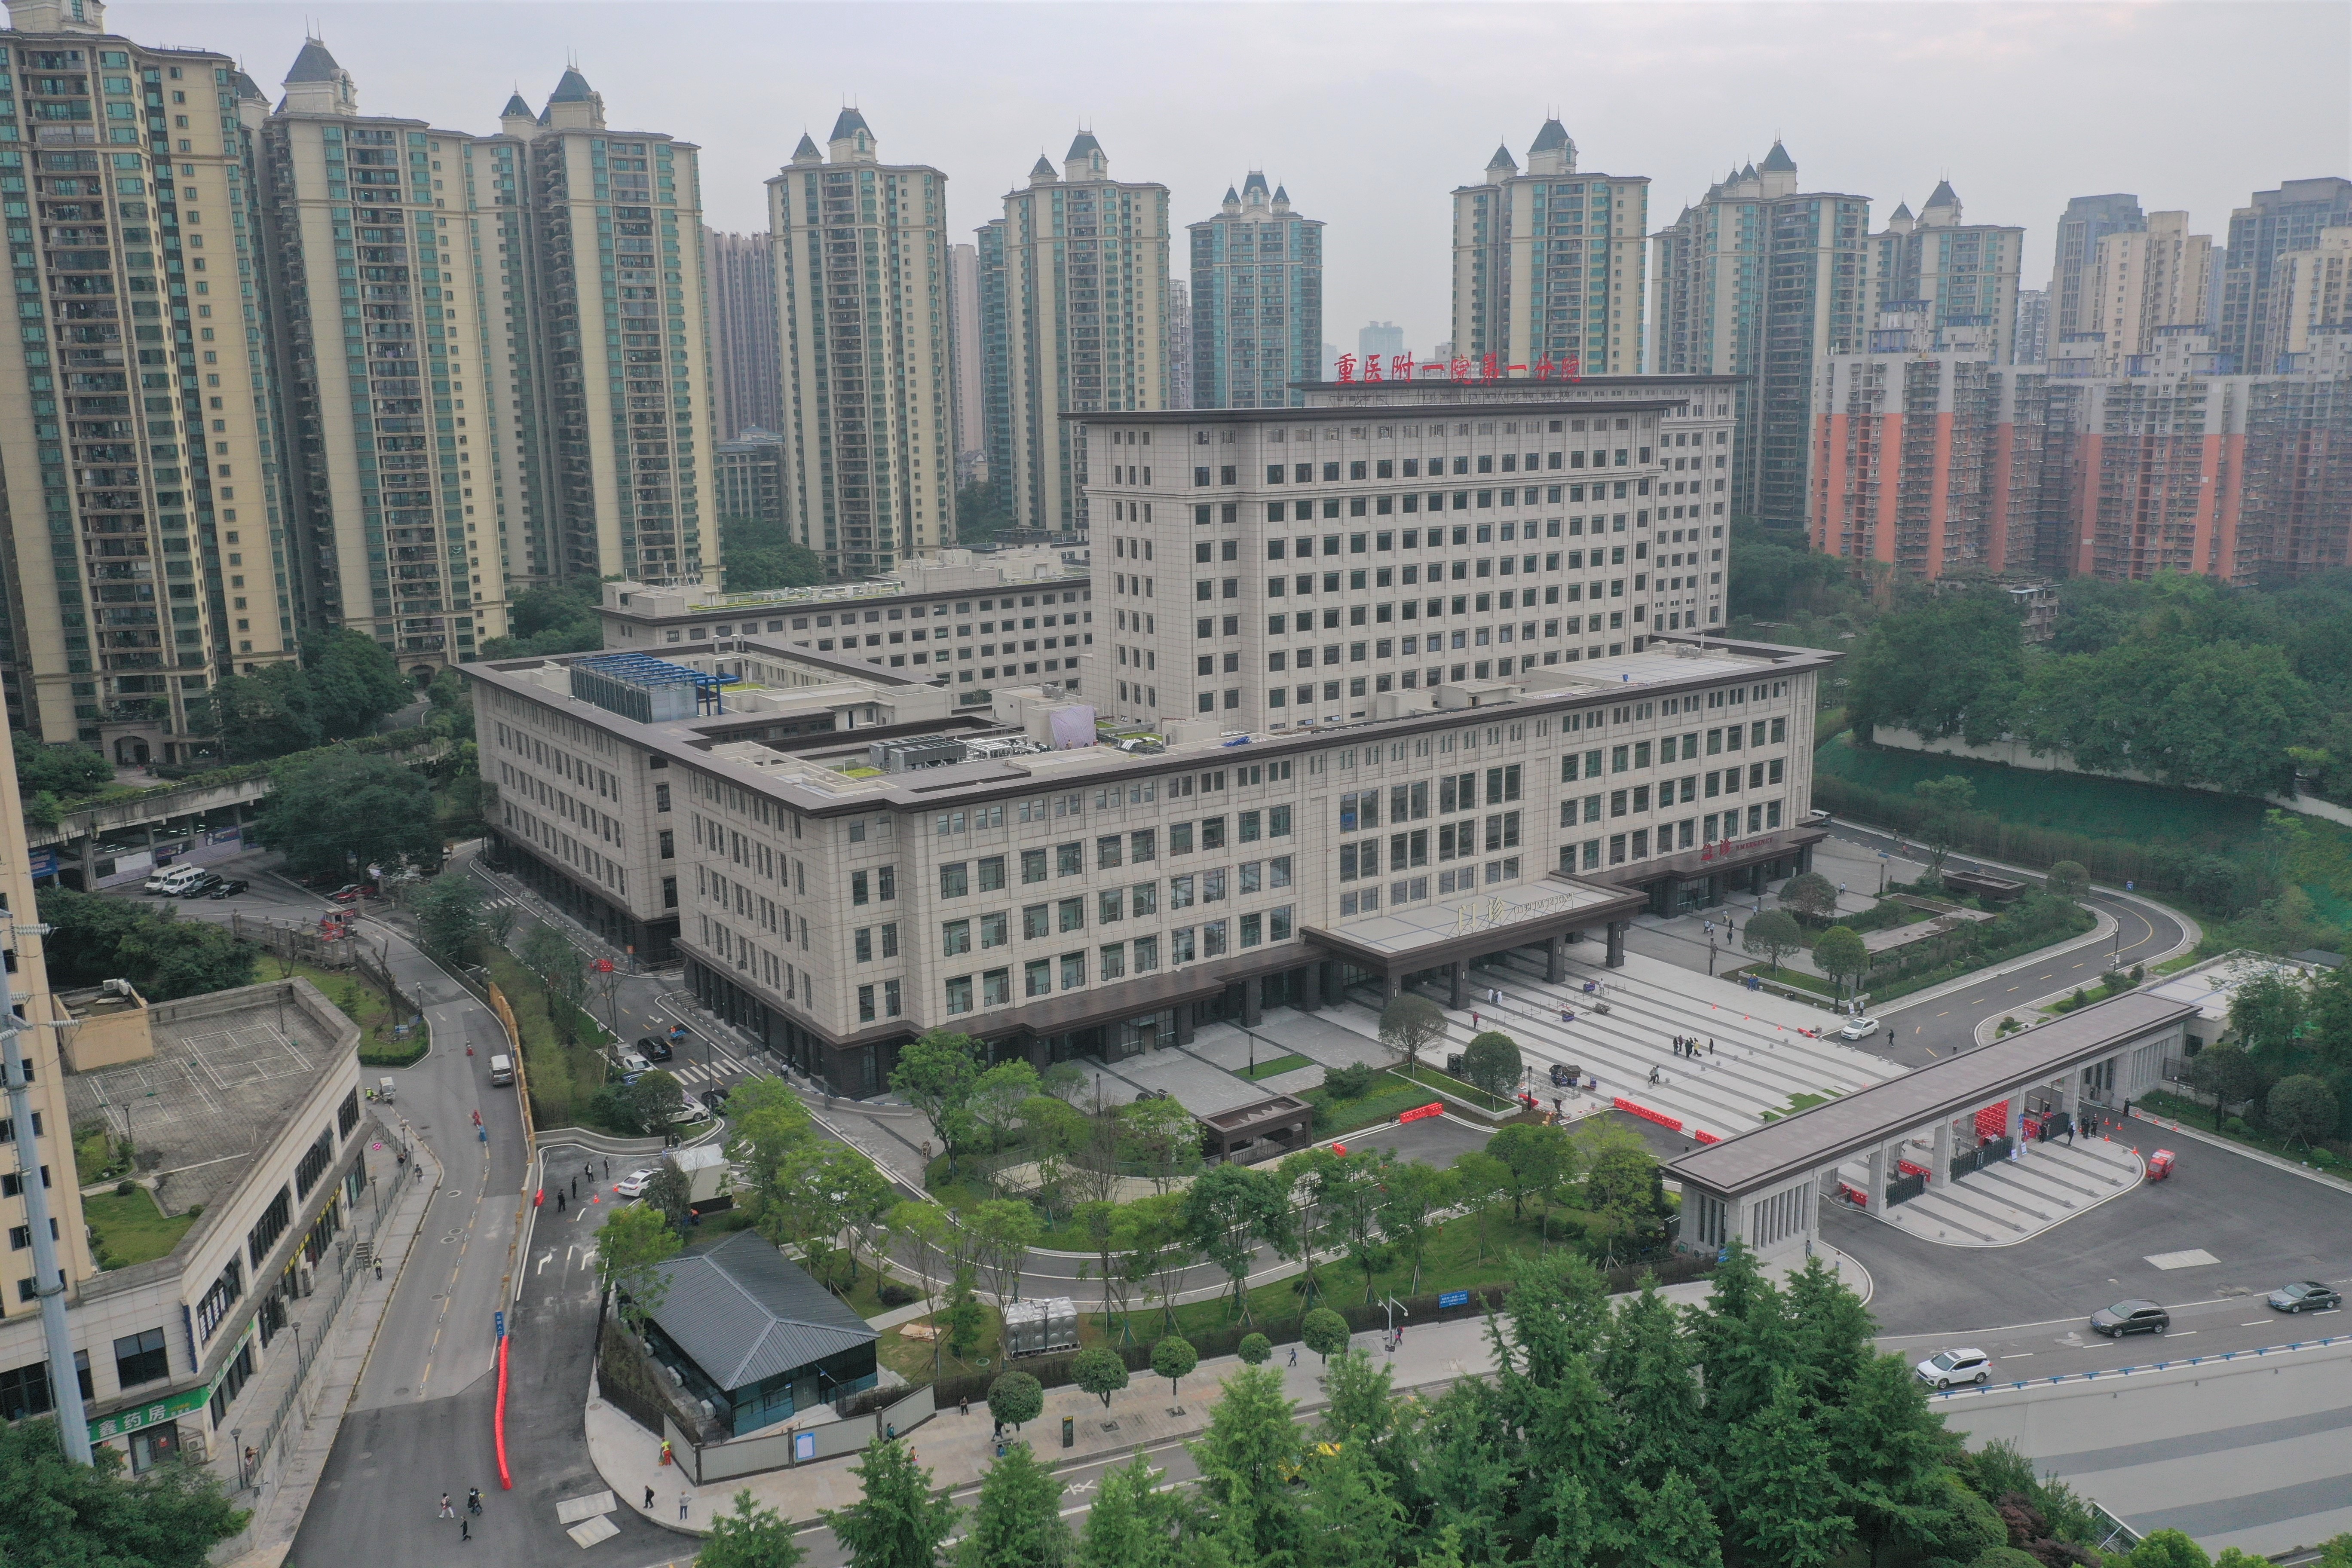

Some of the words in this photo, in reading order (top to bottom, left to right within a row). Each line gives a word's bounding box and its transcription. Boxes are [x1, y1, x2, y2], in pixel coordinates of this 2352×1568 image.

[1334, 351, 1581, 386] 重医附一院第一分院
[1701, 838, 1732, 861] 急诊
[1458, 896, 1506, 931] 门诊
[86, 1404, 166, 1438] 鑫药房
